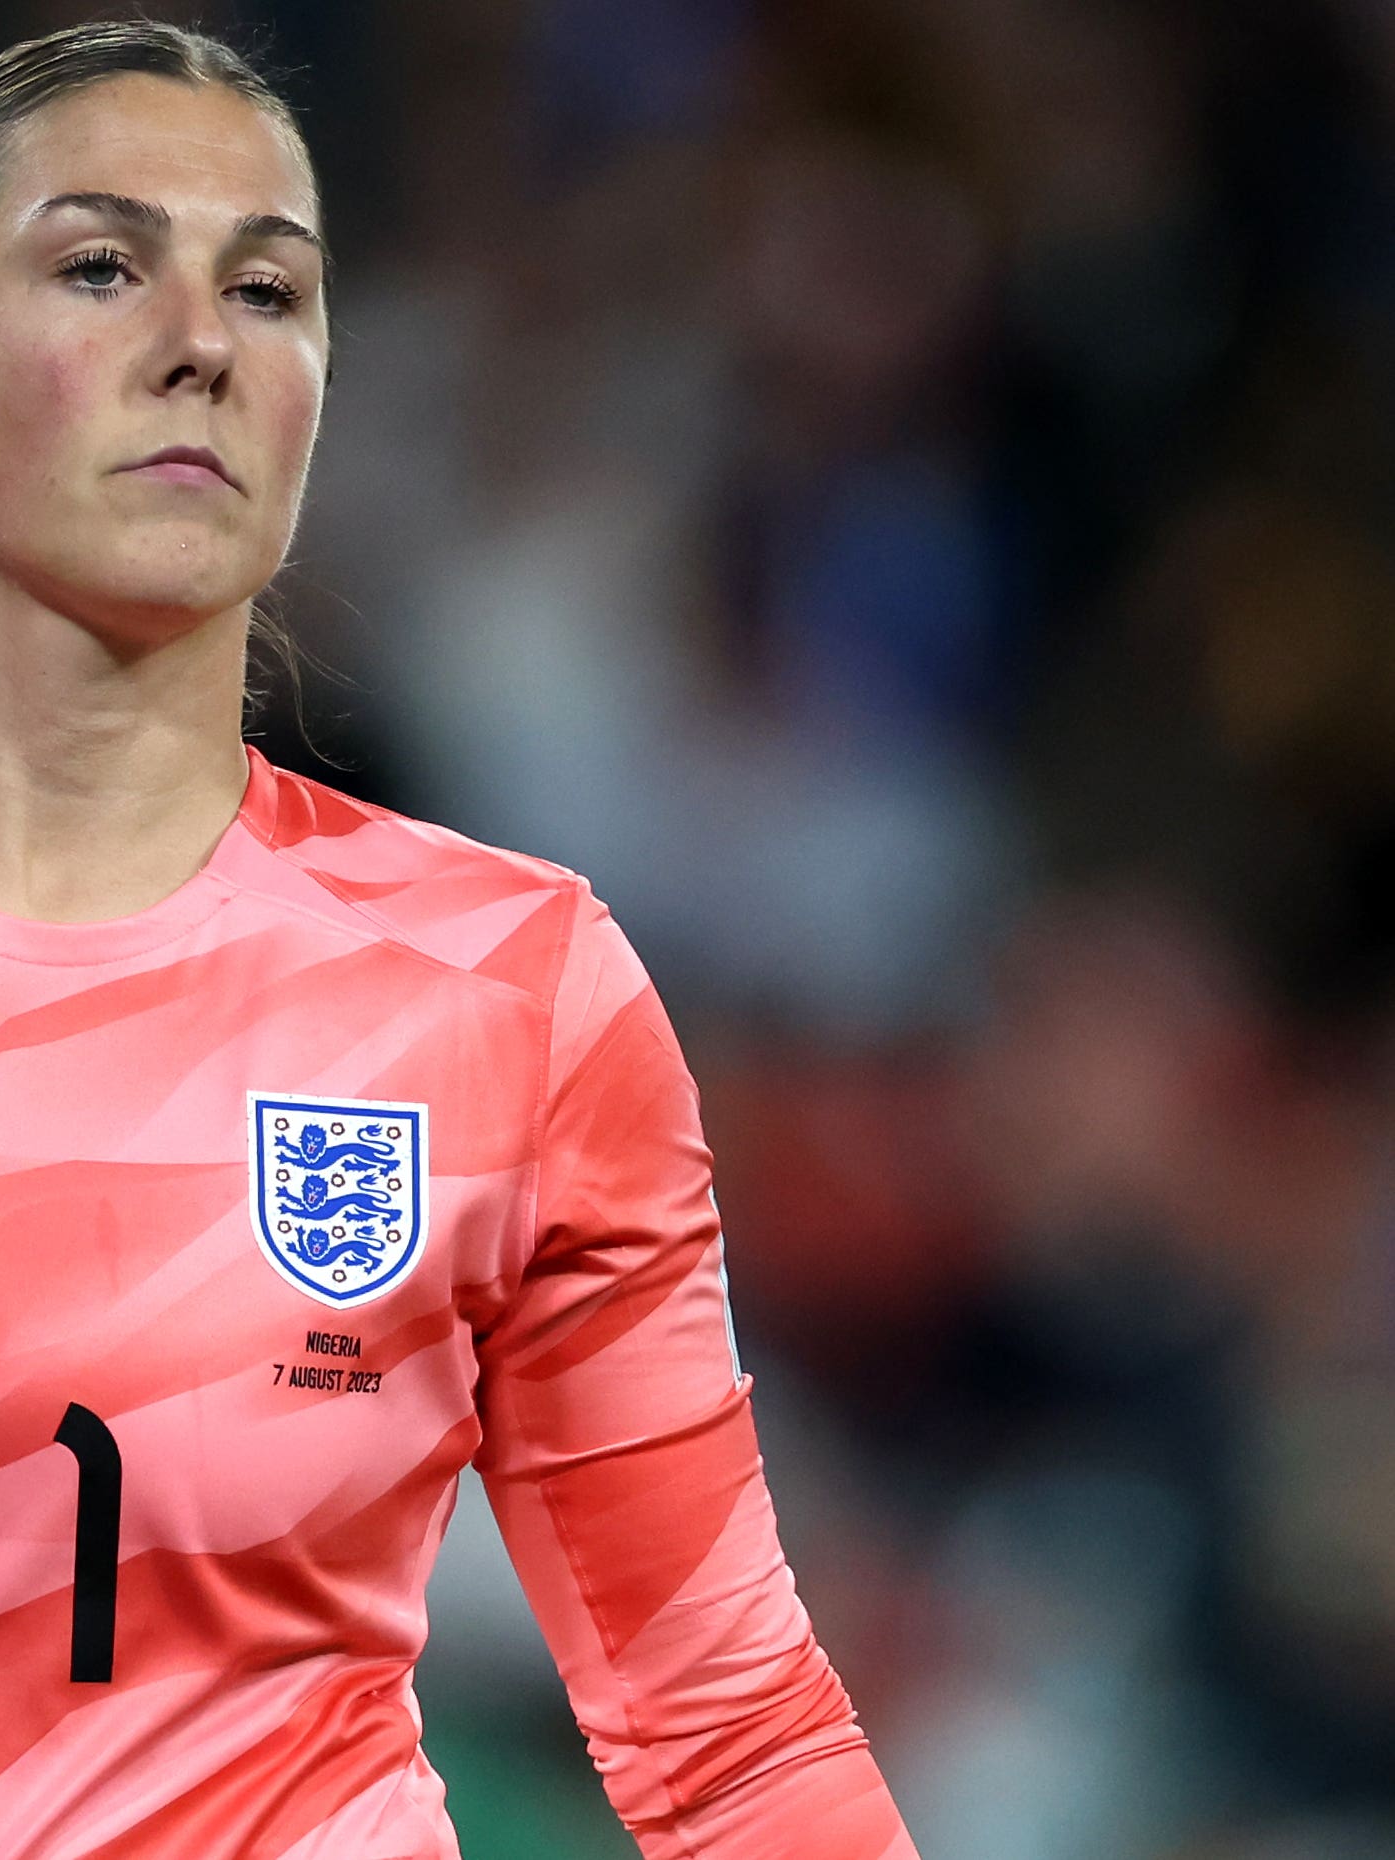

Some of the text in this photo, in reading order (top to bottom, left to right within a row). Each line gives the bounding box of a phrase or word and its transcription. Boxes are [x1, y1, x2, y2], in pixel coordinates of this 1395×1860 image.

[306, 1330, 361, 1359] NIGERIA
[273, 1364, 382, 1393] 7 AUGUST 2023
[53, 1401, 122, 1683] 1
